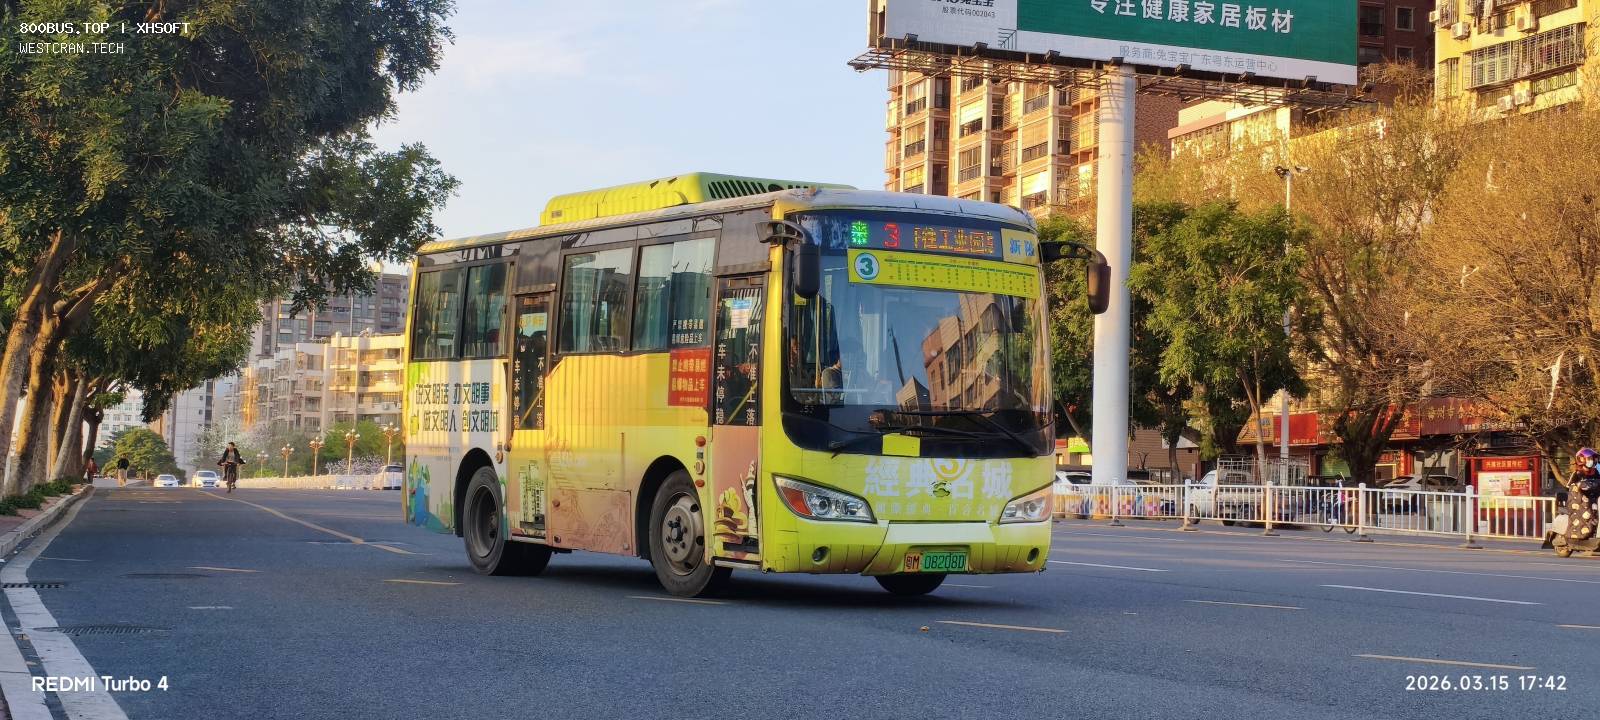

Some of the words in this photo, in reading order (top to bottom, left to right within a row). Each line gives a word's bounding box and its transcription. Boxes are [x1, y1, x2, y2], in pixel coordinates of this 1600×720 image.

[1090, 0, 1294, 34] 专注健康家居板材
[882, 223, 900, 248] 3
[859, 257, 874, 275] 3
[415, 383, 449, 405] 说文明话
[453, 382, 490, 405] 办文明事
[716, 342, 726, 425] 车未停稳
[746, 343, 758, 425] 不准上落
[924, 553, 965, 569] 08208D
